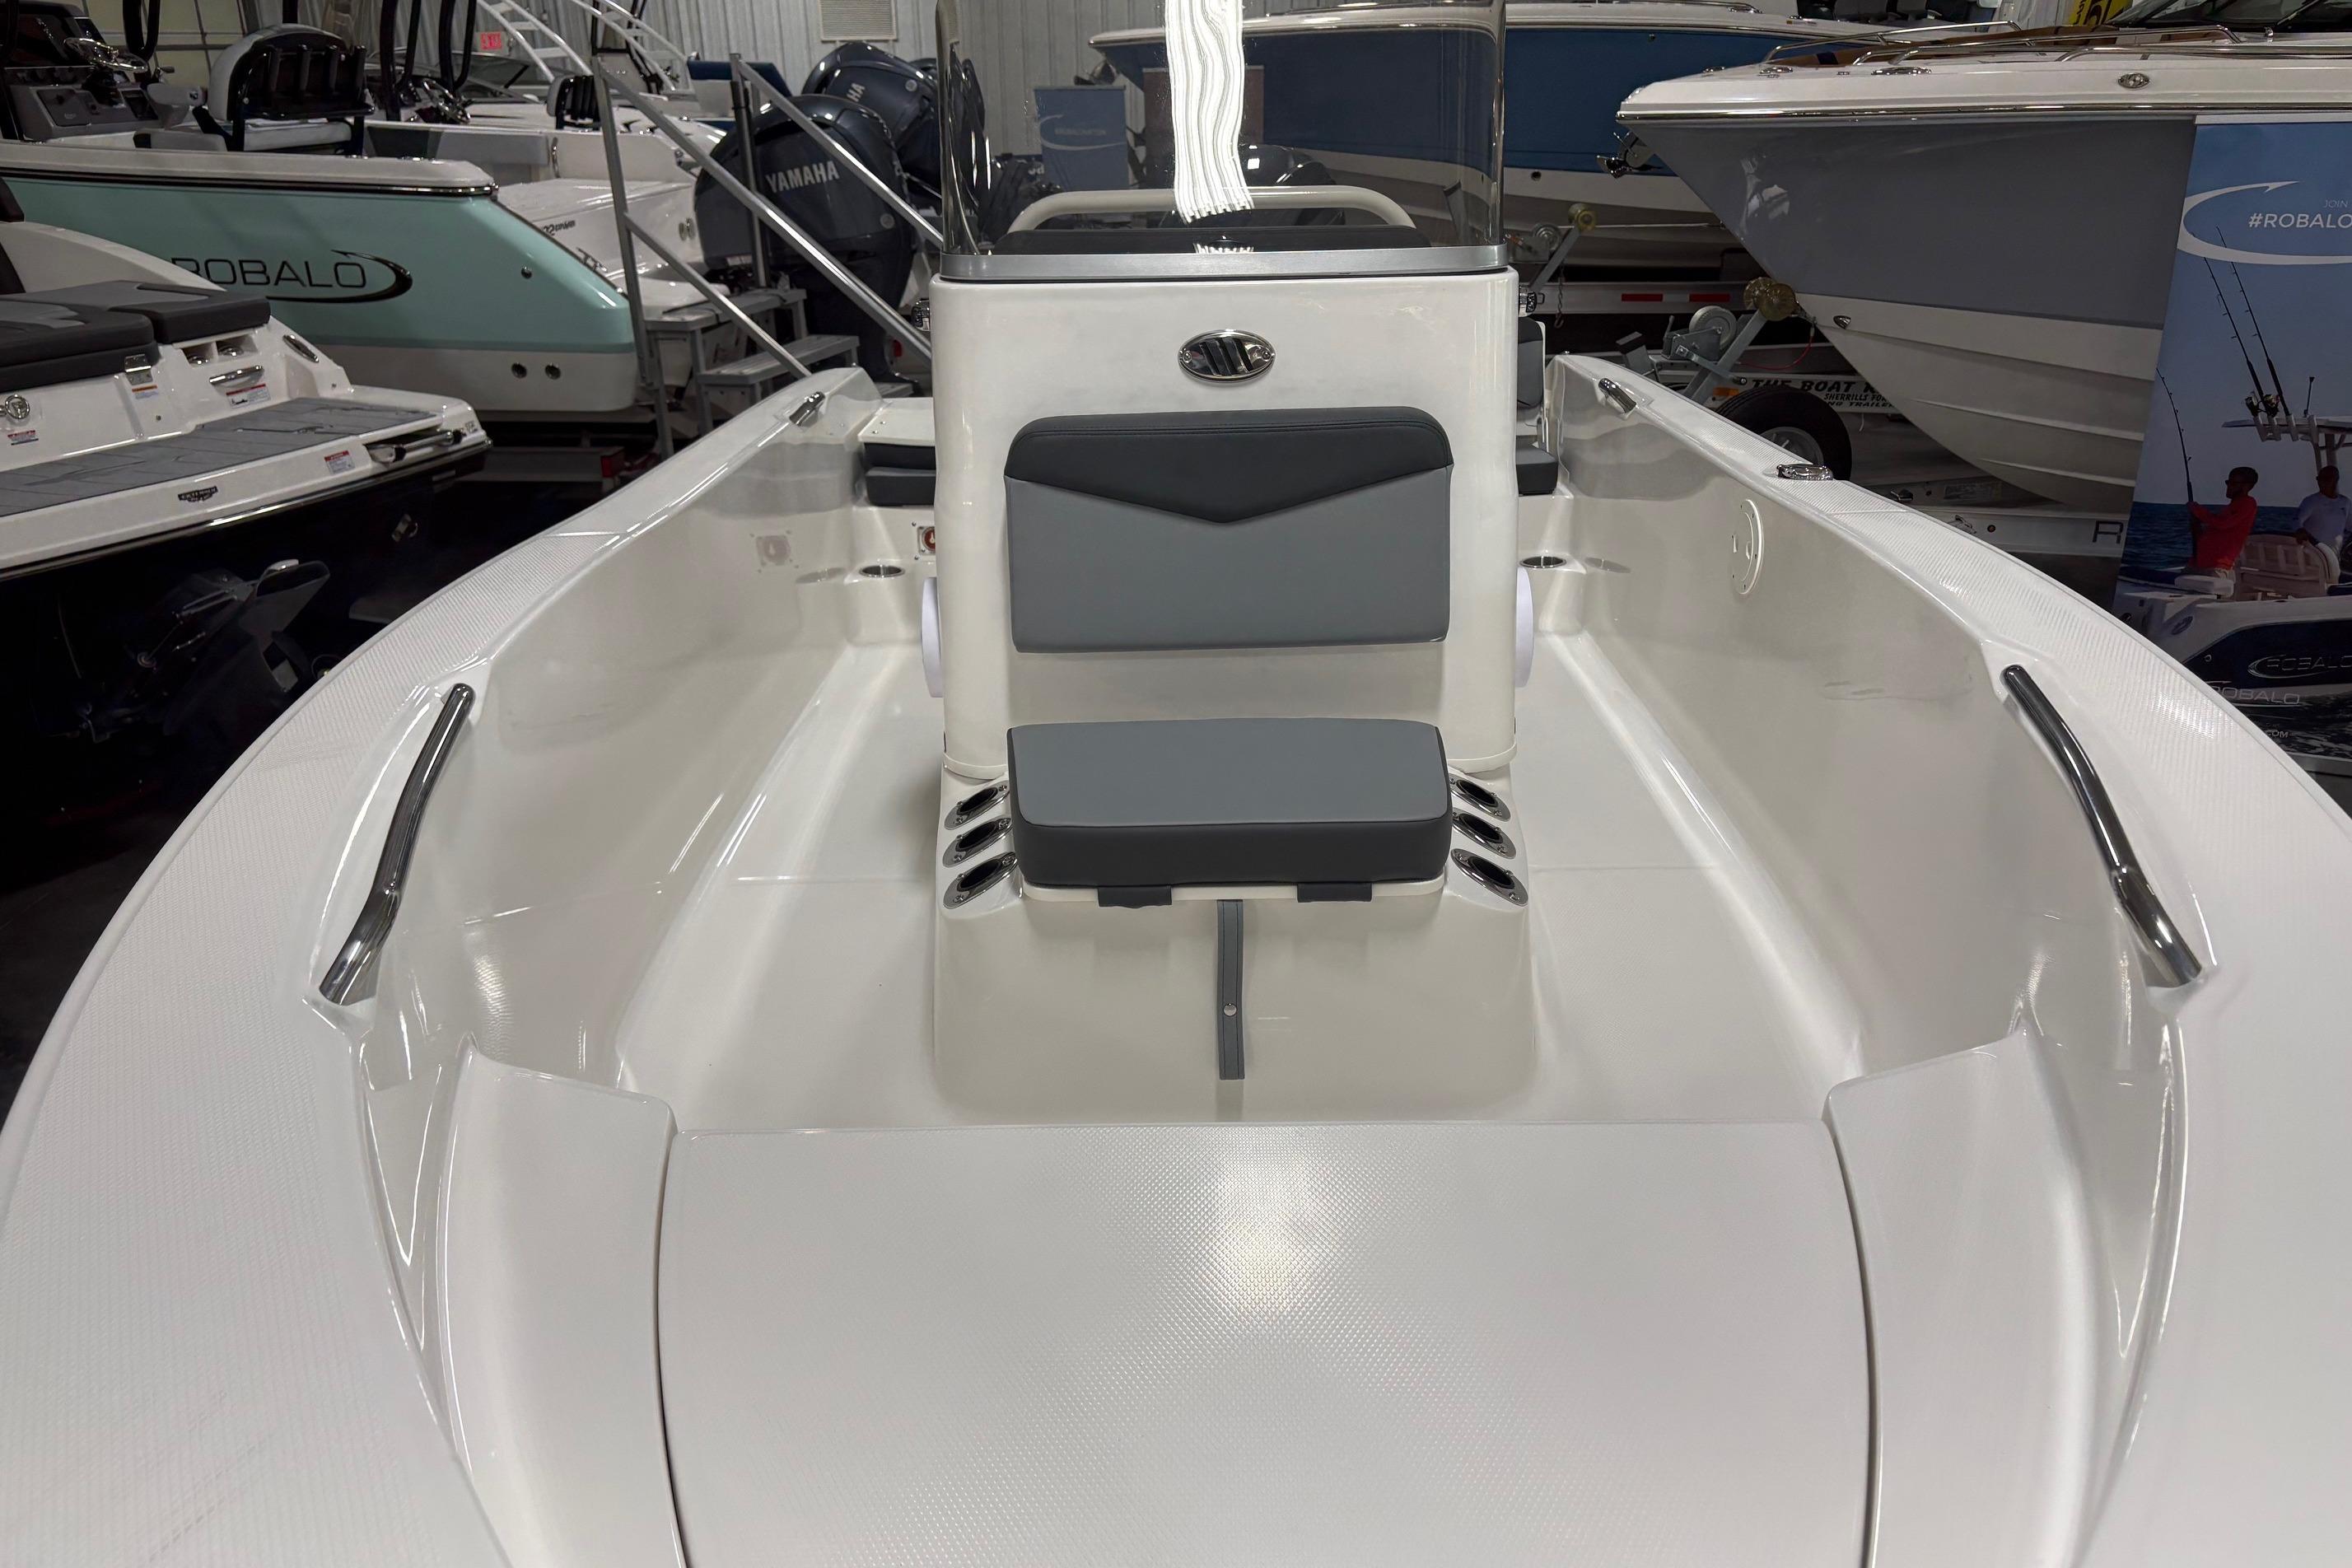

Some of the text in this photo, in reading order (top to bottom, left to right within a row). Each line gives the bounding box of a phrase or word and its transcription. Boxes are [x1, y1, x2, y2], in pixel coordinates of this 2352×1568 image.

[766, 161, 840, 194] YAMAHA
[2323, 199, 2349, 209] JOIN
[2248, 212, 2352, 229] #ROBALO
[1801, 380, 1856, 393] BOAT
